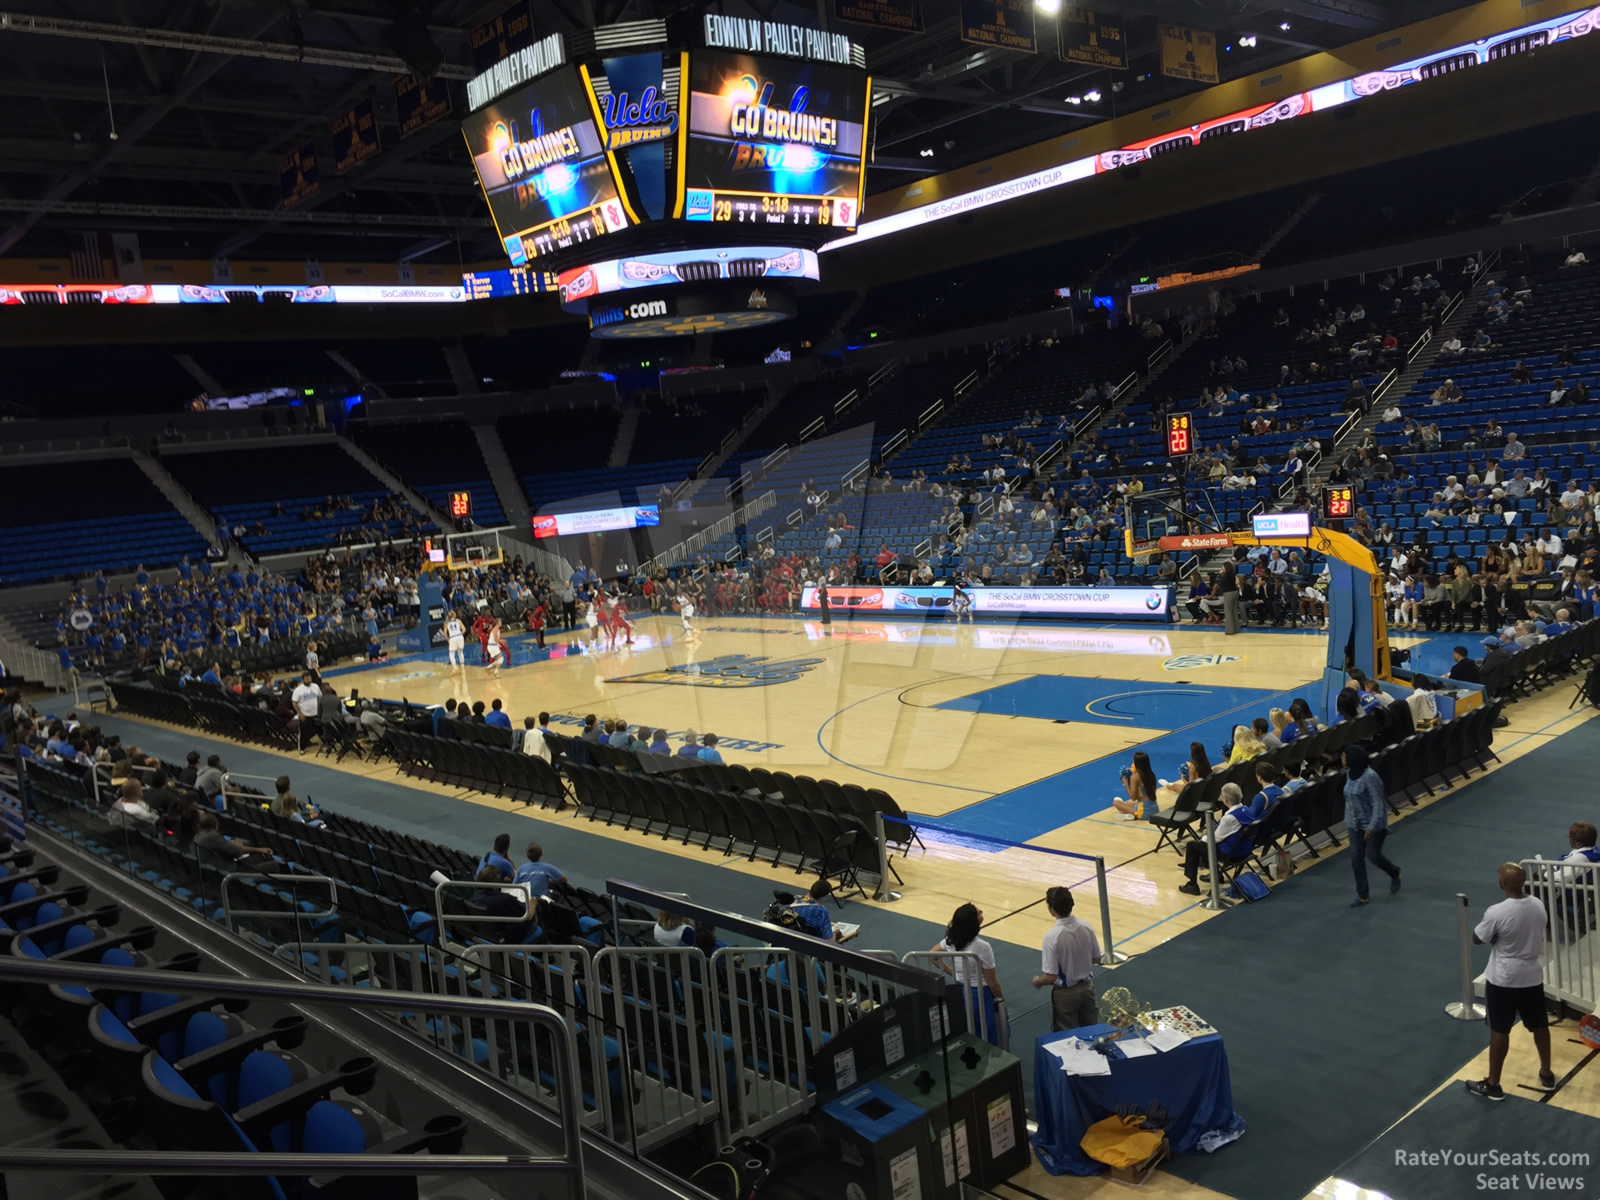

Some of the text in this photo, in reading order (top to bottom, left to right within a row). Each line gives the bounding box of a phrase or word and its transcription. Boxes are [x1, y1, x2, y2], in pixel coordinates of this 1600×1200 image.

[705, 14, 850, 65] EDWIN W PAULEY PAVILION
[493, 51, 520, 95] PAULEY
[520, 32, 562, 82] PAVILION
[602, 86, 678, 130] Ucla
[731, 102, 836, 147] GO BRUINS!
[610, 126, 671, 148] BRUINS
[501, 148, 524, 180] GO
[523, 127, 580, 170] BRUINS!
[762, 197, 789, 213] 3:18
[924, 170, 1063, 219] THE SoCal BMW CROSSTOWN CUP.
[715, 200, 732, 221] 29
[738, 212, 756, 222] 3 4
[793, 214, 810, 224] 3 3
[818, 205, 830, 225] 19
[381, 289, 445, 298] SoCalBMW.com
[1280, 519, 1307, 529] Health
[988, 592, 1002, 600] THE
[1003, 592, 1021, 600] SoCal
[1023, 592, 1042, 600] BMW
[1042, 593, 1091, 601] CROSSTOWN
